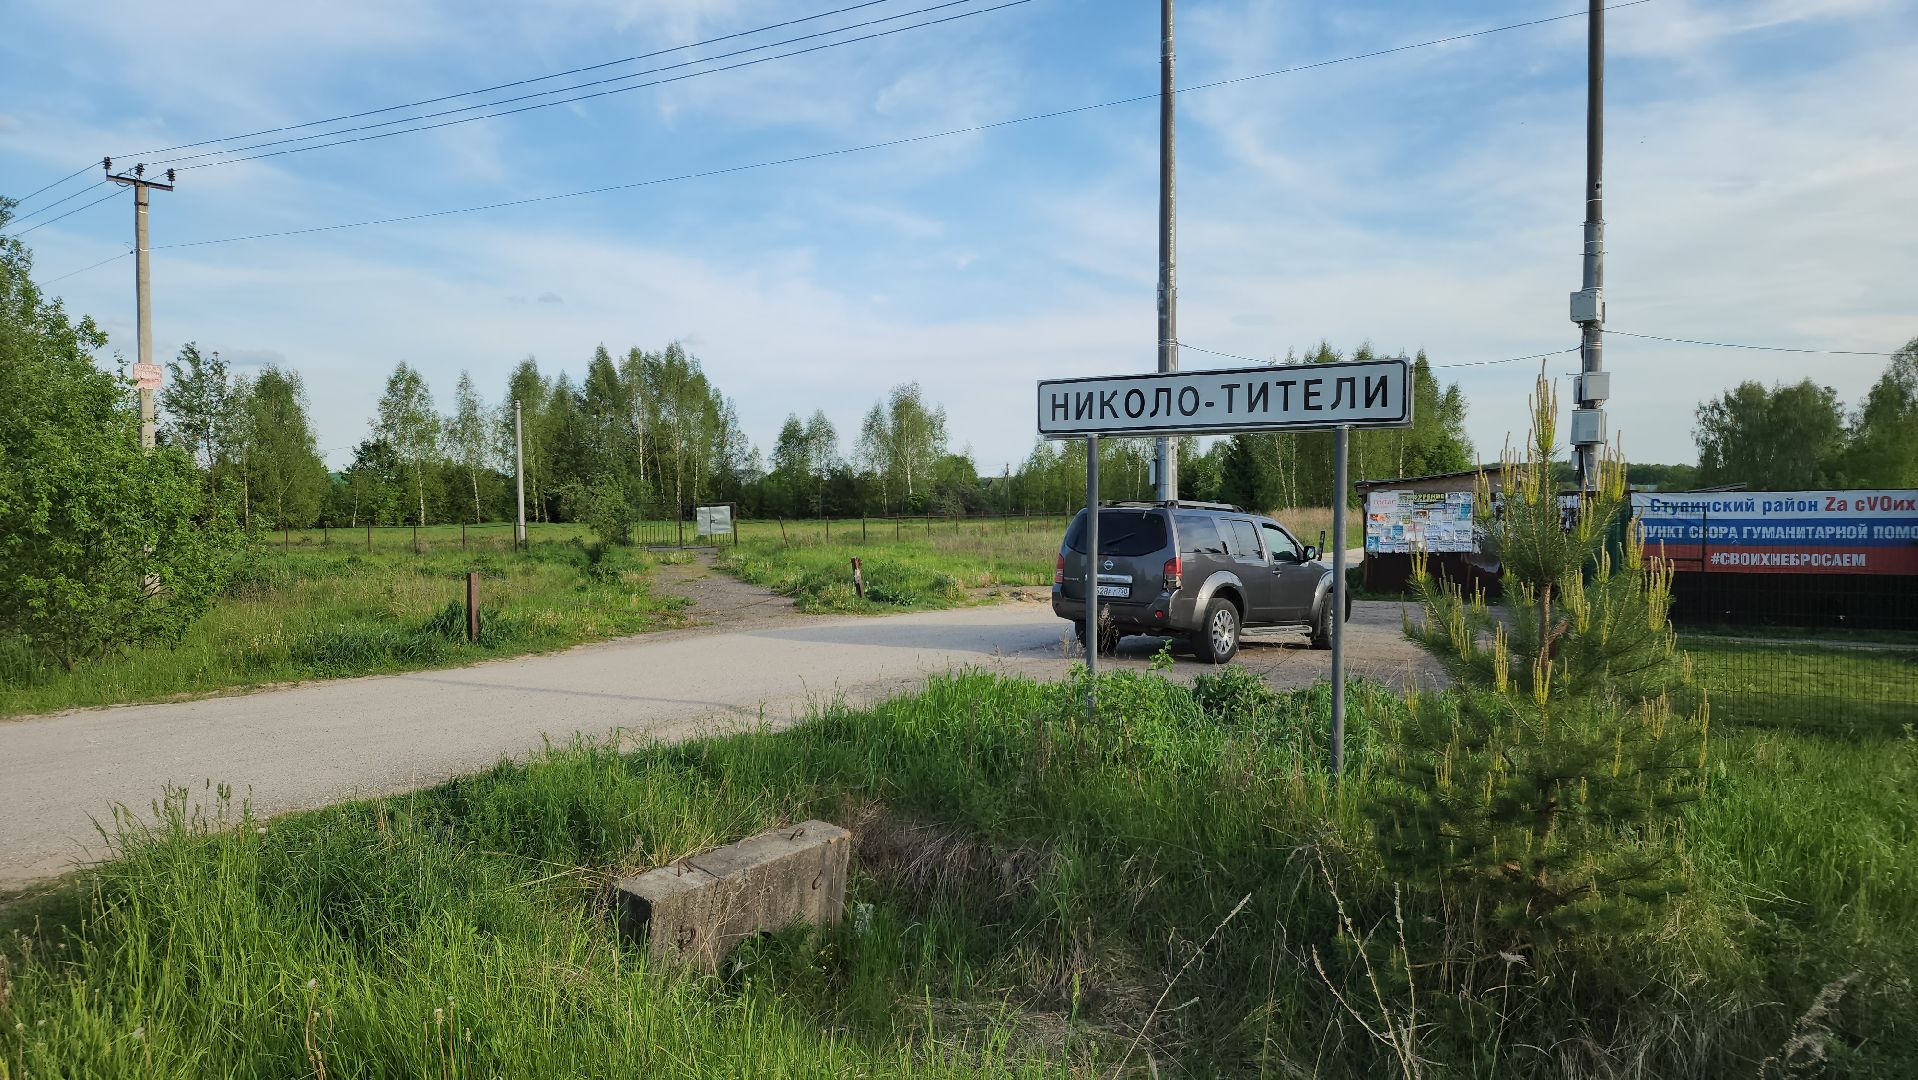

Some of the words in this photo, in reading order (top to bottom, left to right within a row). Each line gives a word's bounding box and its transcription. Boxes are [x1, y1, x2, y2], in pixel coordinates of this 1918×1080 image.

[1051, 376, 1388, 421] НИКОЛО-ТИТЕЛИ
[1650, 498, 1755, 515] Ступинский
[1762, 498, 1818, 515] район
[1824, 496, 1848, 512] Za
[1742, 523, 1868, 539] ГУМАНИТАРНОЙ
[1711, 552, 1867, 567] #СВОИХНЕБРОСАЕМ
